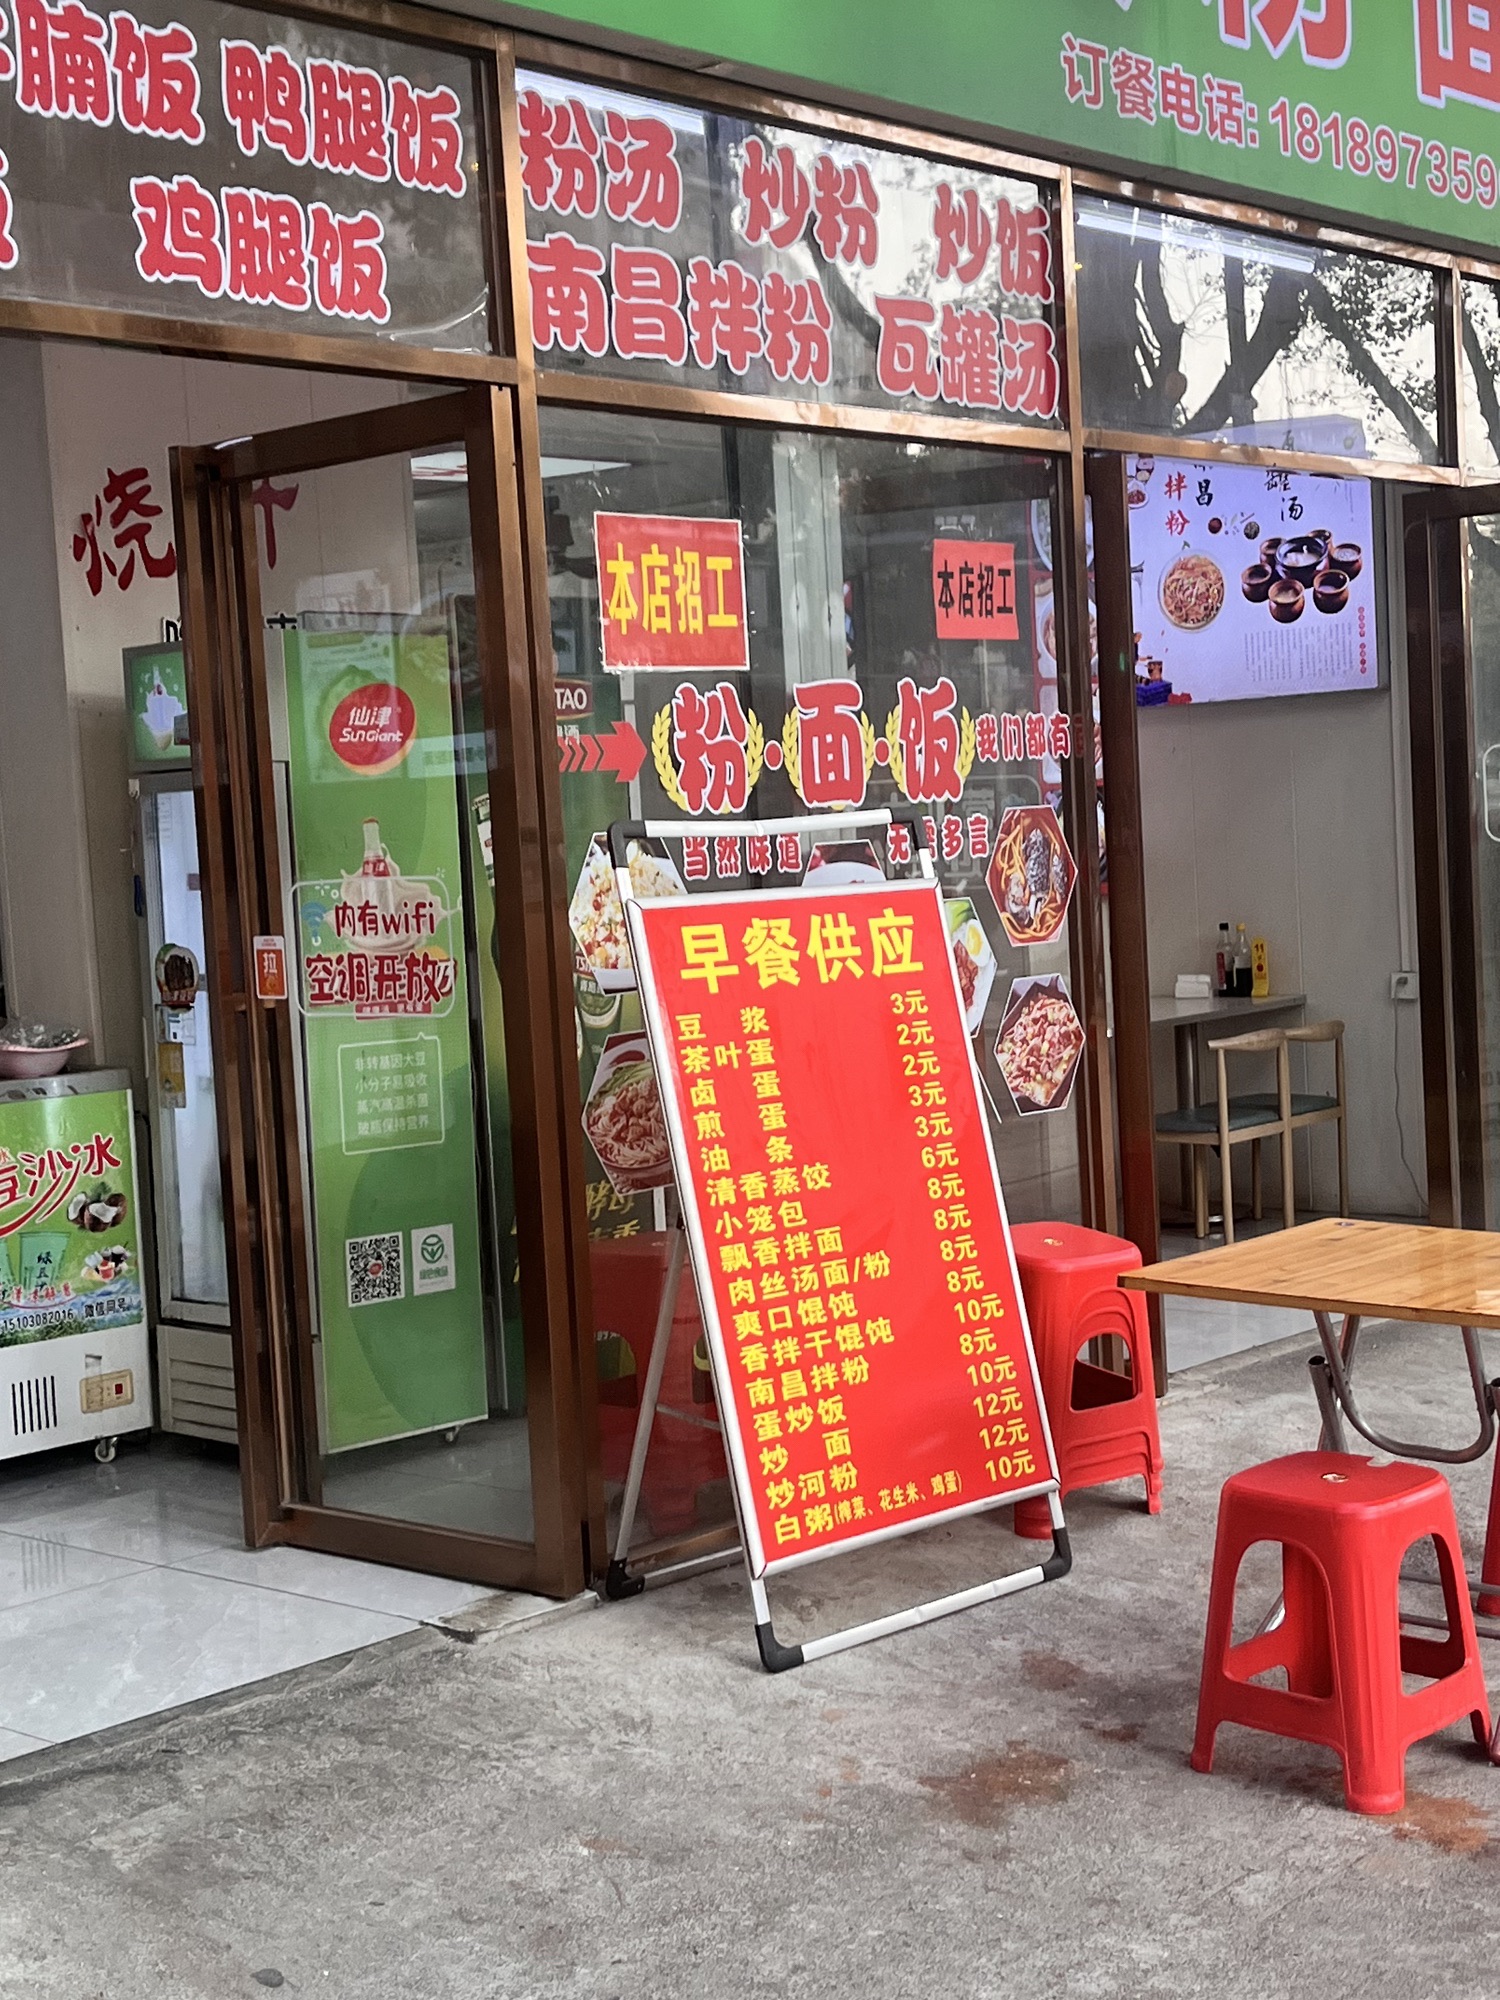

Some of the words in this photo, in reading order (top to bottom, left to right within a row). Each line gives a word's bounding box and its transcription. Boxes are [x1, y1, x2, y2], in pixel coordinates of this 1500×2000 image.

[0, 0, 205, 145] 腩饭
[220, 39, 467, 198] 鸭腿饭
[518, 89, 682, 233] 粉汤
[741, 134, 880, 269] 炒粉
[933, 182, 1055, 304] 炒饭
[130, 174, 391, 324] 鸡腿饭
[526, 231, 832, 387] 南昌拌粉
[875, 293, 1061, 420] 瓦罐汤
[1163, 470, 1191, 536] 拌粉
[606, 542, 739, 636] 本店招工
[936, 560, 1015, 620] 本店招工
[338, 726, 404, 744] SunGiant
[975, 712, 1071, 763] 我们都有
[333, 900, 436, 937] 内有wifi
[680, 907, 925, 995] 早餐供应
[305, 951, 442, 1004] 空调开放
[891, 990, 929, 1015] 3元
[681, 1038, 775, 1074] 茶叶蛋
[897, 1020, 935, 1046] 2元
[902, 1051, 941, 1077] 2元
[909, 1081, 947, 1107] 3元
[915, 1112, 953, 1138] 3元
[706, 1162, 832, 1207] 清香蒸饺
[921, 1142, 959, 1169] 6元
[715, 1200, 808, 1239] 小笼包
[928, 1173, 965, 1200] 8元
[719, 1226, 844, 1273] 飘香拌面
[934, 1204, 972, 1231] 8元
[729, 1250, 891, 1306] 肉丝汤面/粉
[940, 1235, 978, 1261] 8元
[3, 1308, 74, 1331] 15103082016
[84, 1297, 129, 1319] 微信同号
[733, 1290, 859, 1341] 爽口馄饨
[946, 1265, 985, 1293] 8元
[740, 1317, 895, 1374] 香拌干馄饨
[954, 1293, 1005, 1324] 10元
[746, 1355, 869, 1409] 南昌拌粉
[959, 1327, 997, 1356] 8元
[753, 1394, 847, 1442] 蛋炒饭
[966, 1355, 1017, 1387] 10元
[973, 1386, 1023, 1418] 12元
[766, 1461, 858, 1510] 炒河粉
[979, 1417, 1029, 1450] 12元
[985, 1449, 1036, 1482] 10元
